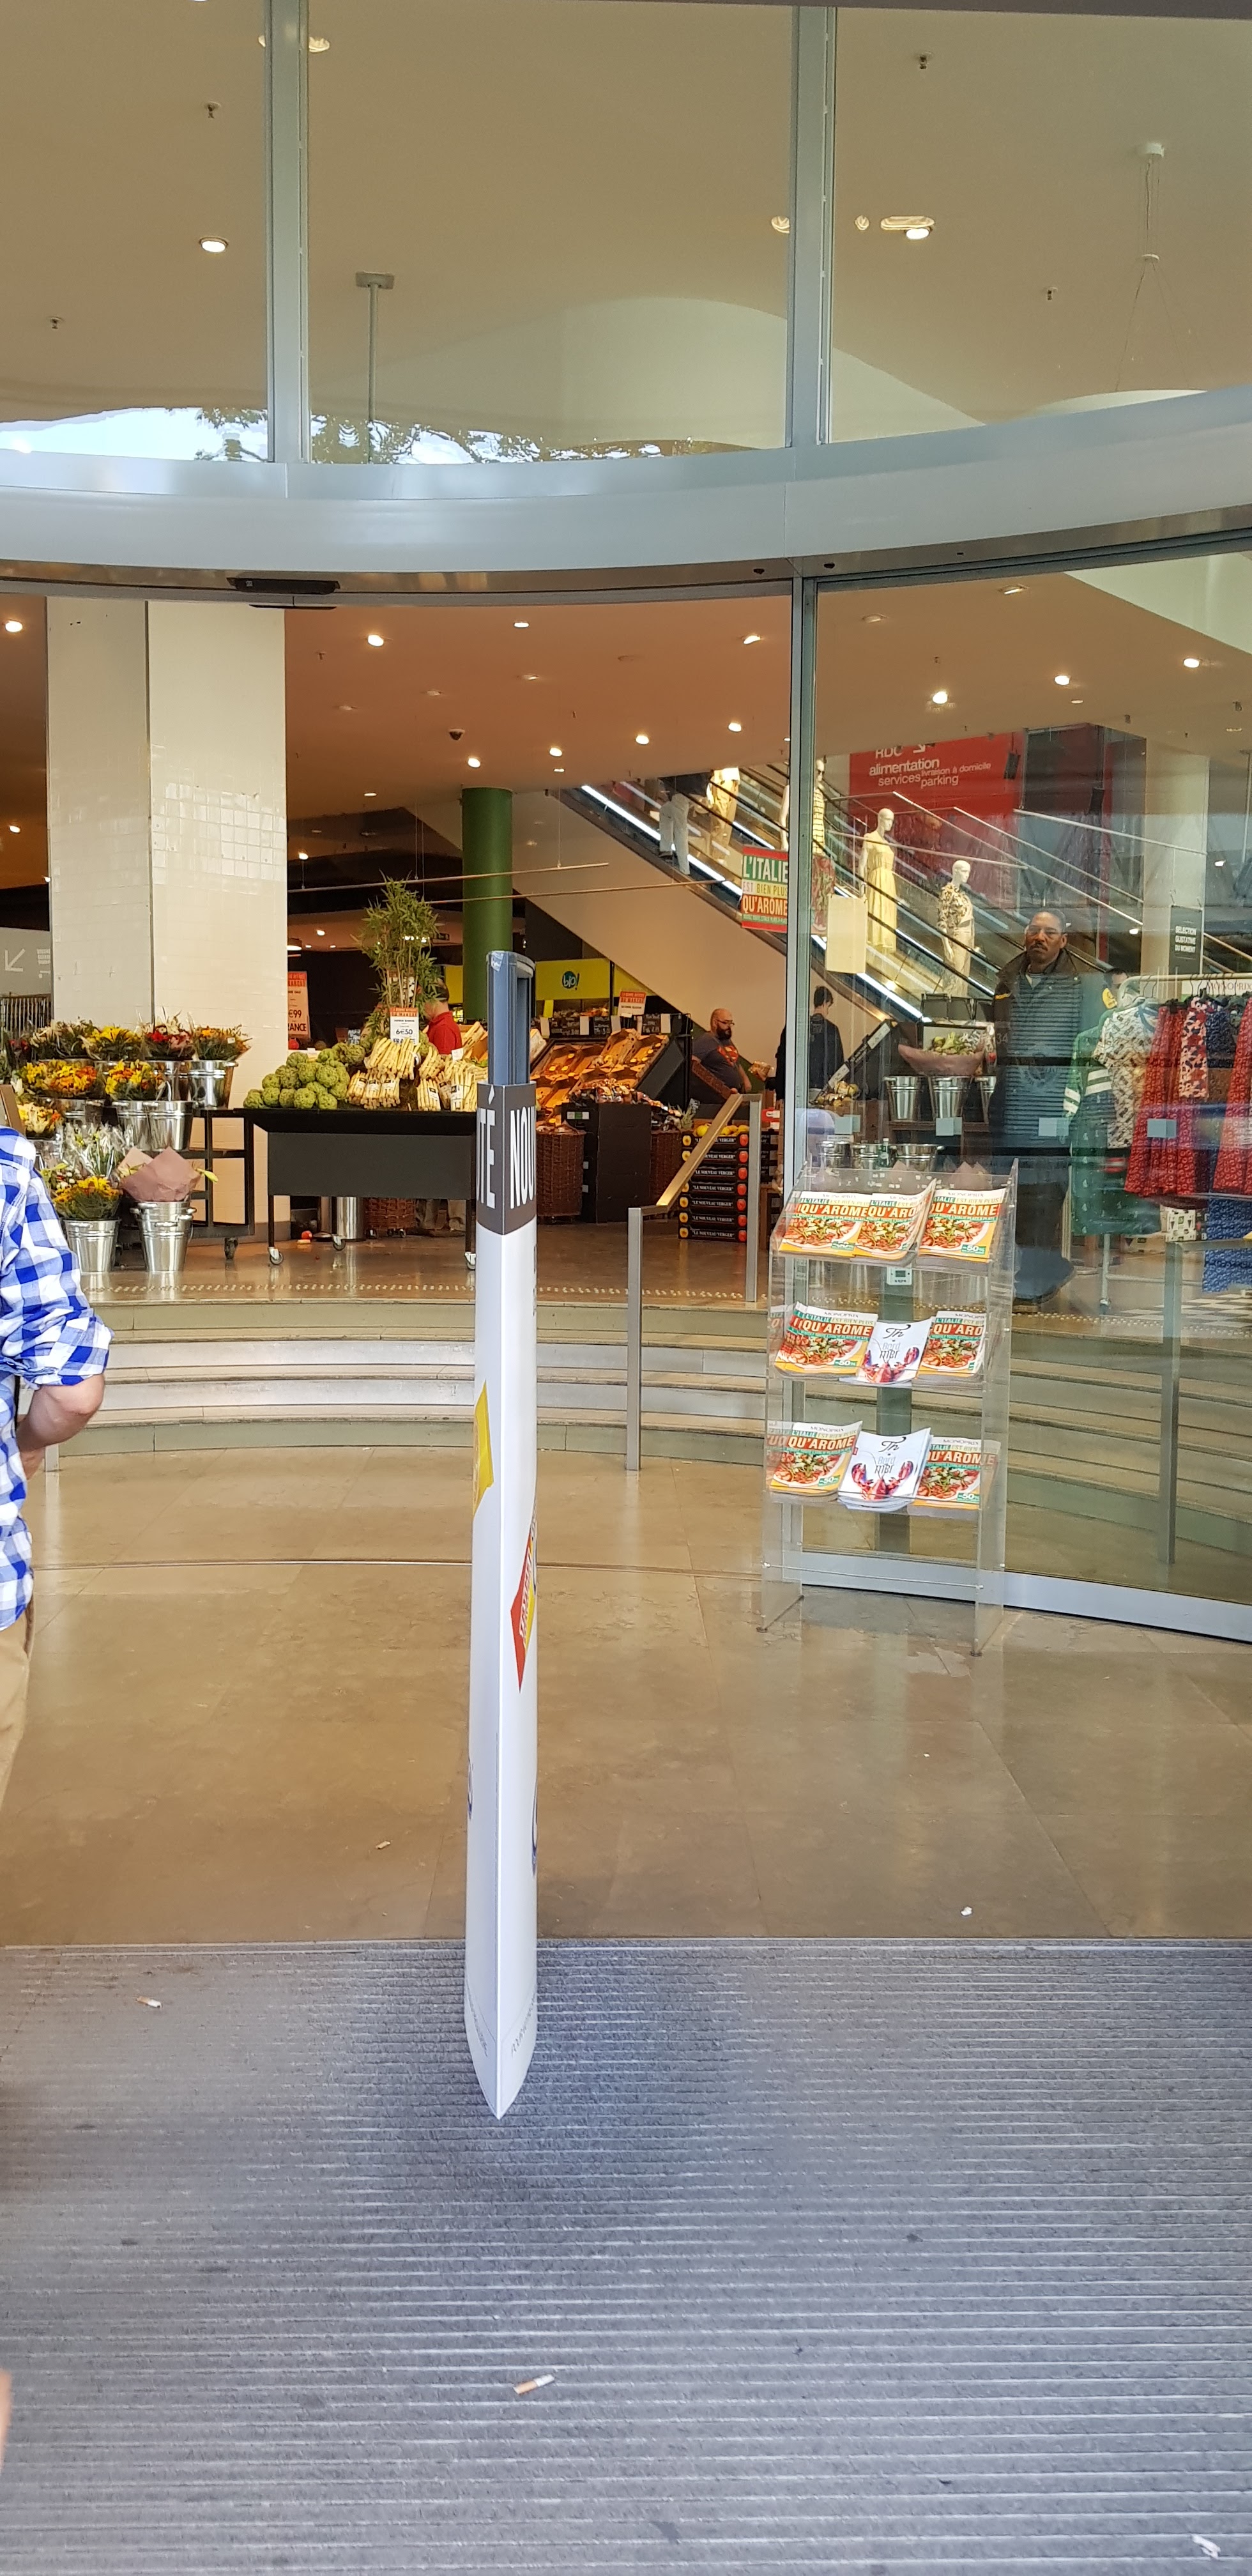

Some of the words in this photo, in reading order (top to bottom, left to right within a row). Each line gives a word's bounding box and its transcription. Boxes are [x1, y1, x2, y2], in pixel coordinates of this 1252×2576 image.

[869, 758, 940, 776] alimentation
[921, 767, 950, 778] livraison
[959, 762, 991, 772] domicile
[878, 773, 921, 786] services
[921, 775, 959, 789] parking
[743, 855, 788, 884] L'ITALIE
[743, 882, 753, 893] EST
[756, 884, 771, 895] BIEN
